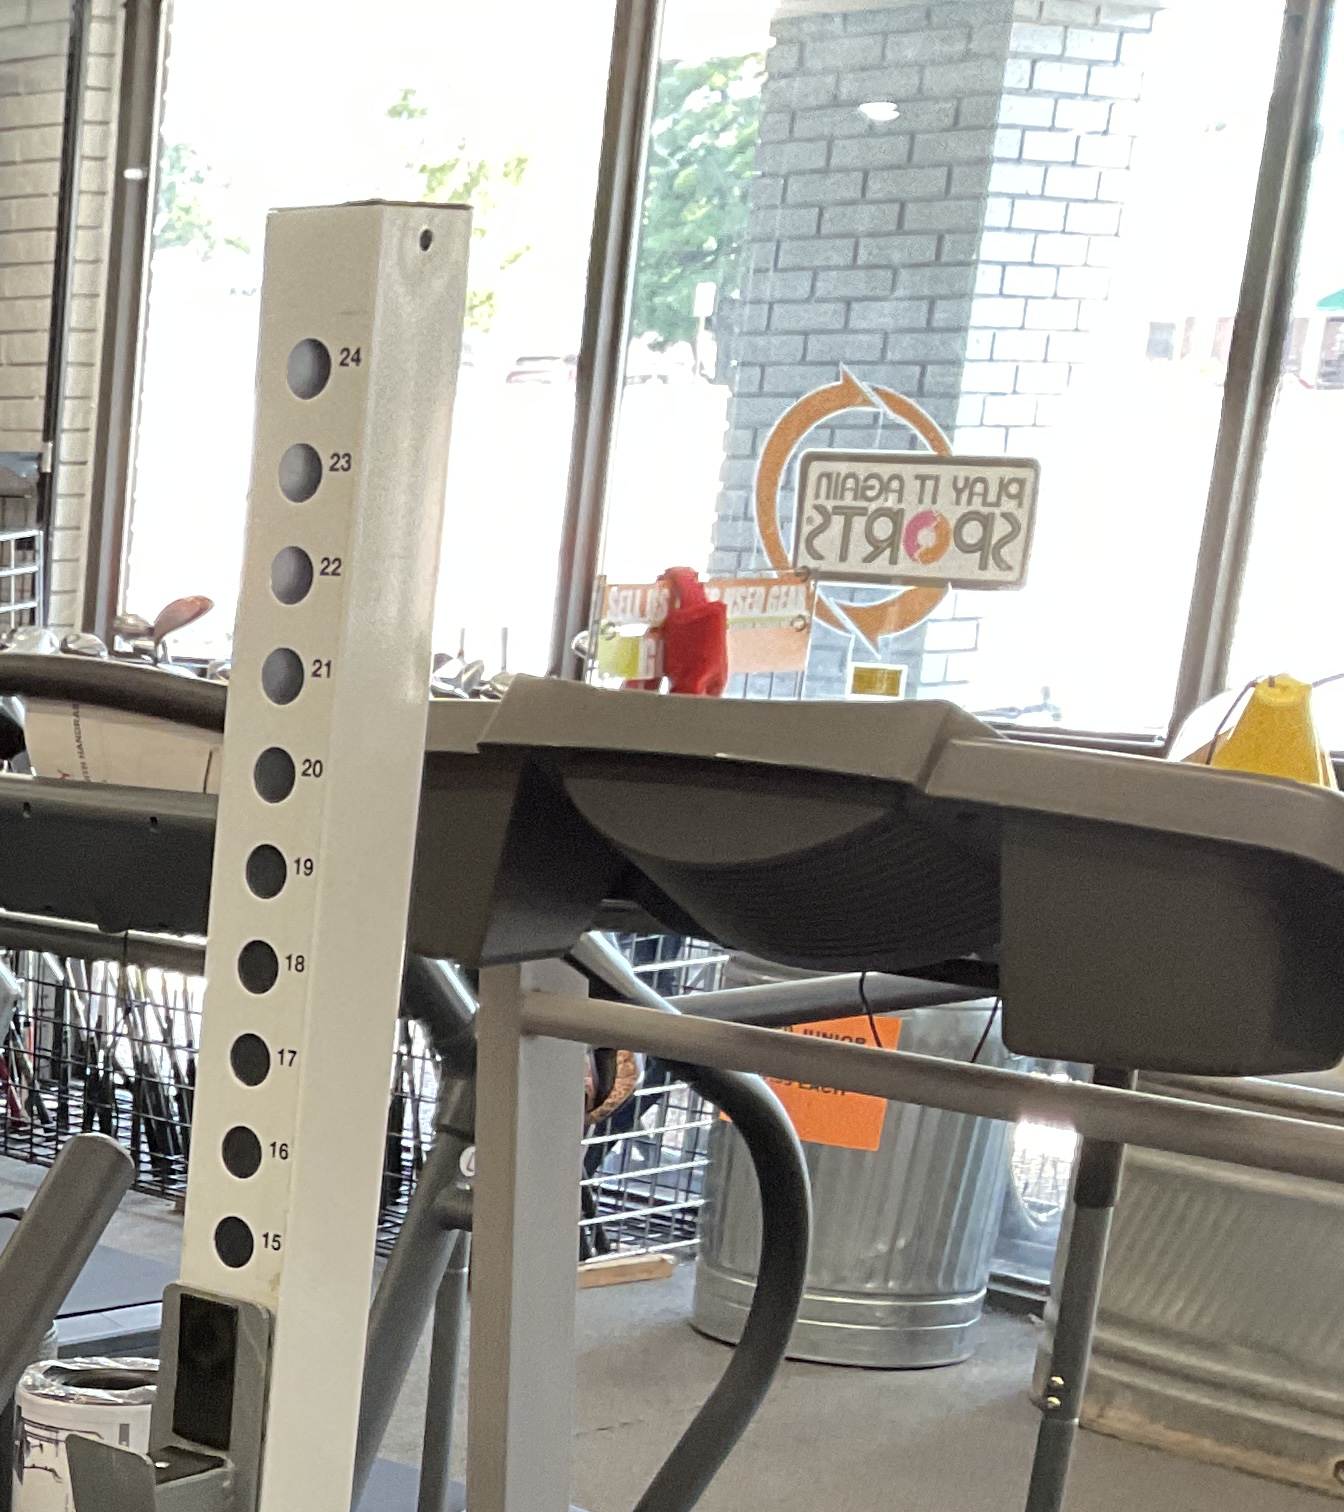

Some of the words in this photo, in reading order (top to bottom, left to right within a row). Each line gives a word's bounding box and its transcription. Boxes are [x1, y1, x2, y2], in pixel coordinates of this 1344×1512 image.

[338, 347, 362, 368] 24
[328, 452, 352, 473] 23
[319, 556, 342, 577] 22
[310, 658, 332, 679] 21
[300, 758, 324, 779] 20
[293, 857, 314, 877] 19
[285, 953, 306, 973] 18
[277, 1047, 298, 1068] 17
[269, 1140, 289, 1161] 16
[261, 1231, 282, 1252] 15
